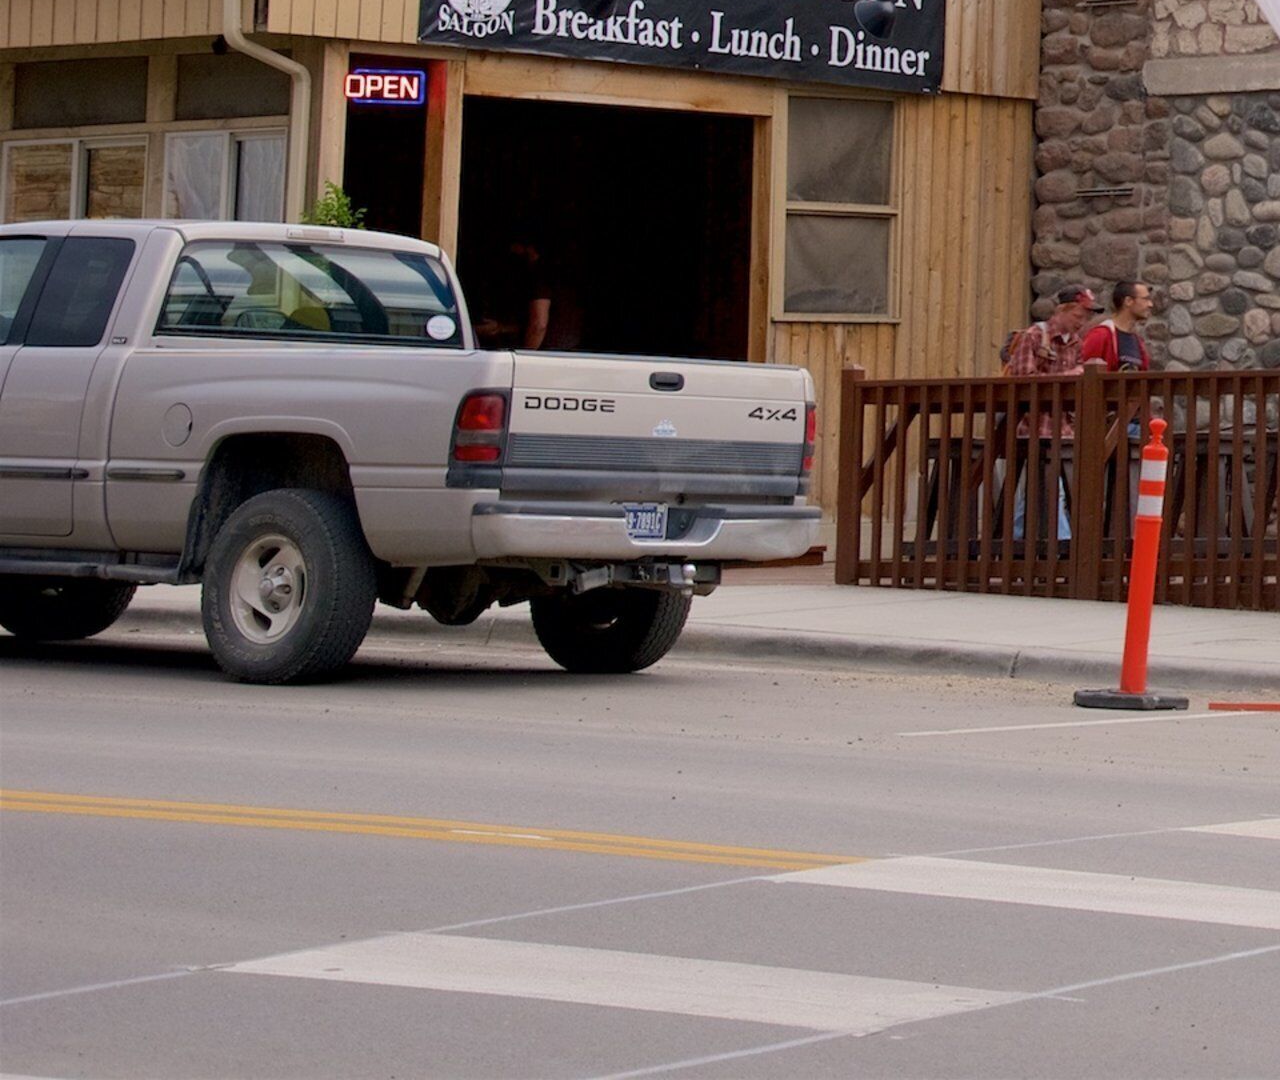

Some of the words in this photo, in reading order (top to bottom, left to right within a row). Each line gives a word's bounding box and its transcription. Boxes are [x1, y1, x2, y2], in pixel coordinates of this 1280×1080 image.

[438, 4, 515, 38] SALOON
[708, 10, 801, 62] Lunch
[828, 25, 930, 76] Dinner
[345, 73, 419, 99] OPEN
[524, 396, 615, 413] DODGE
